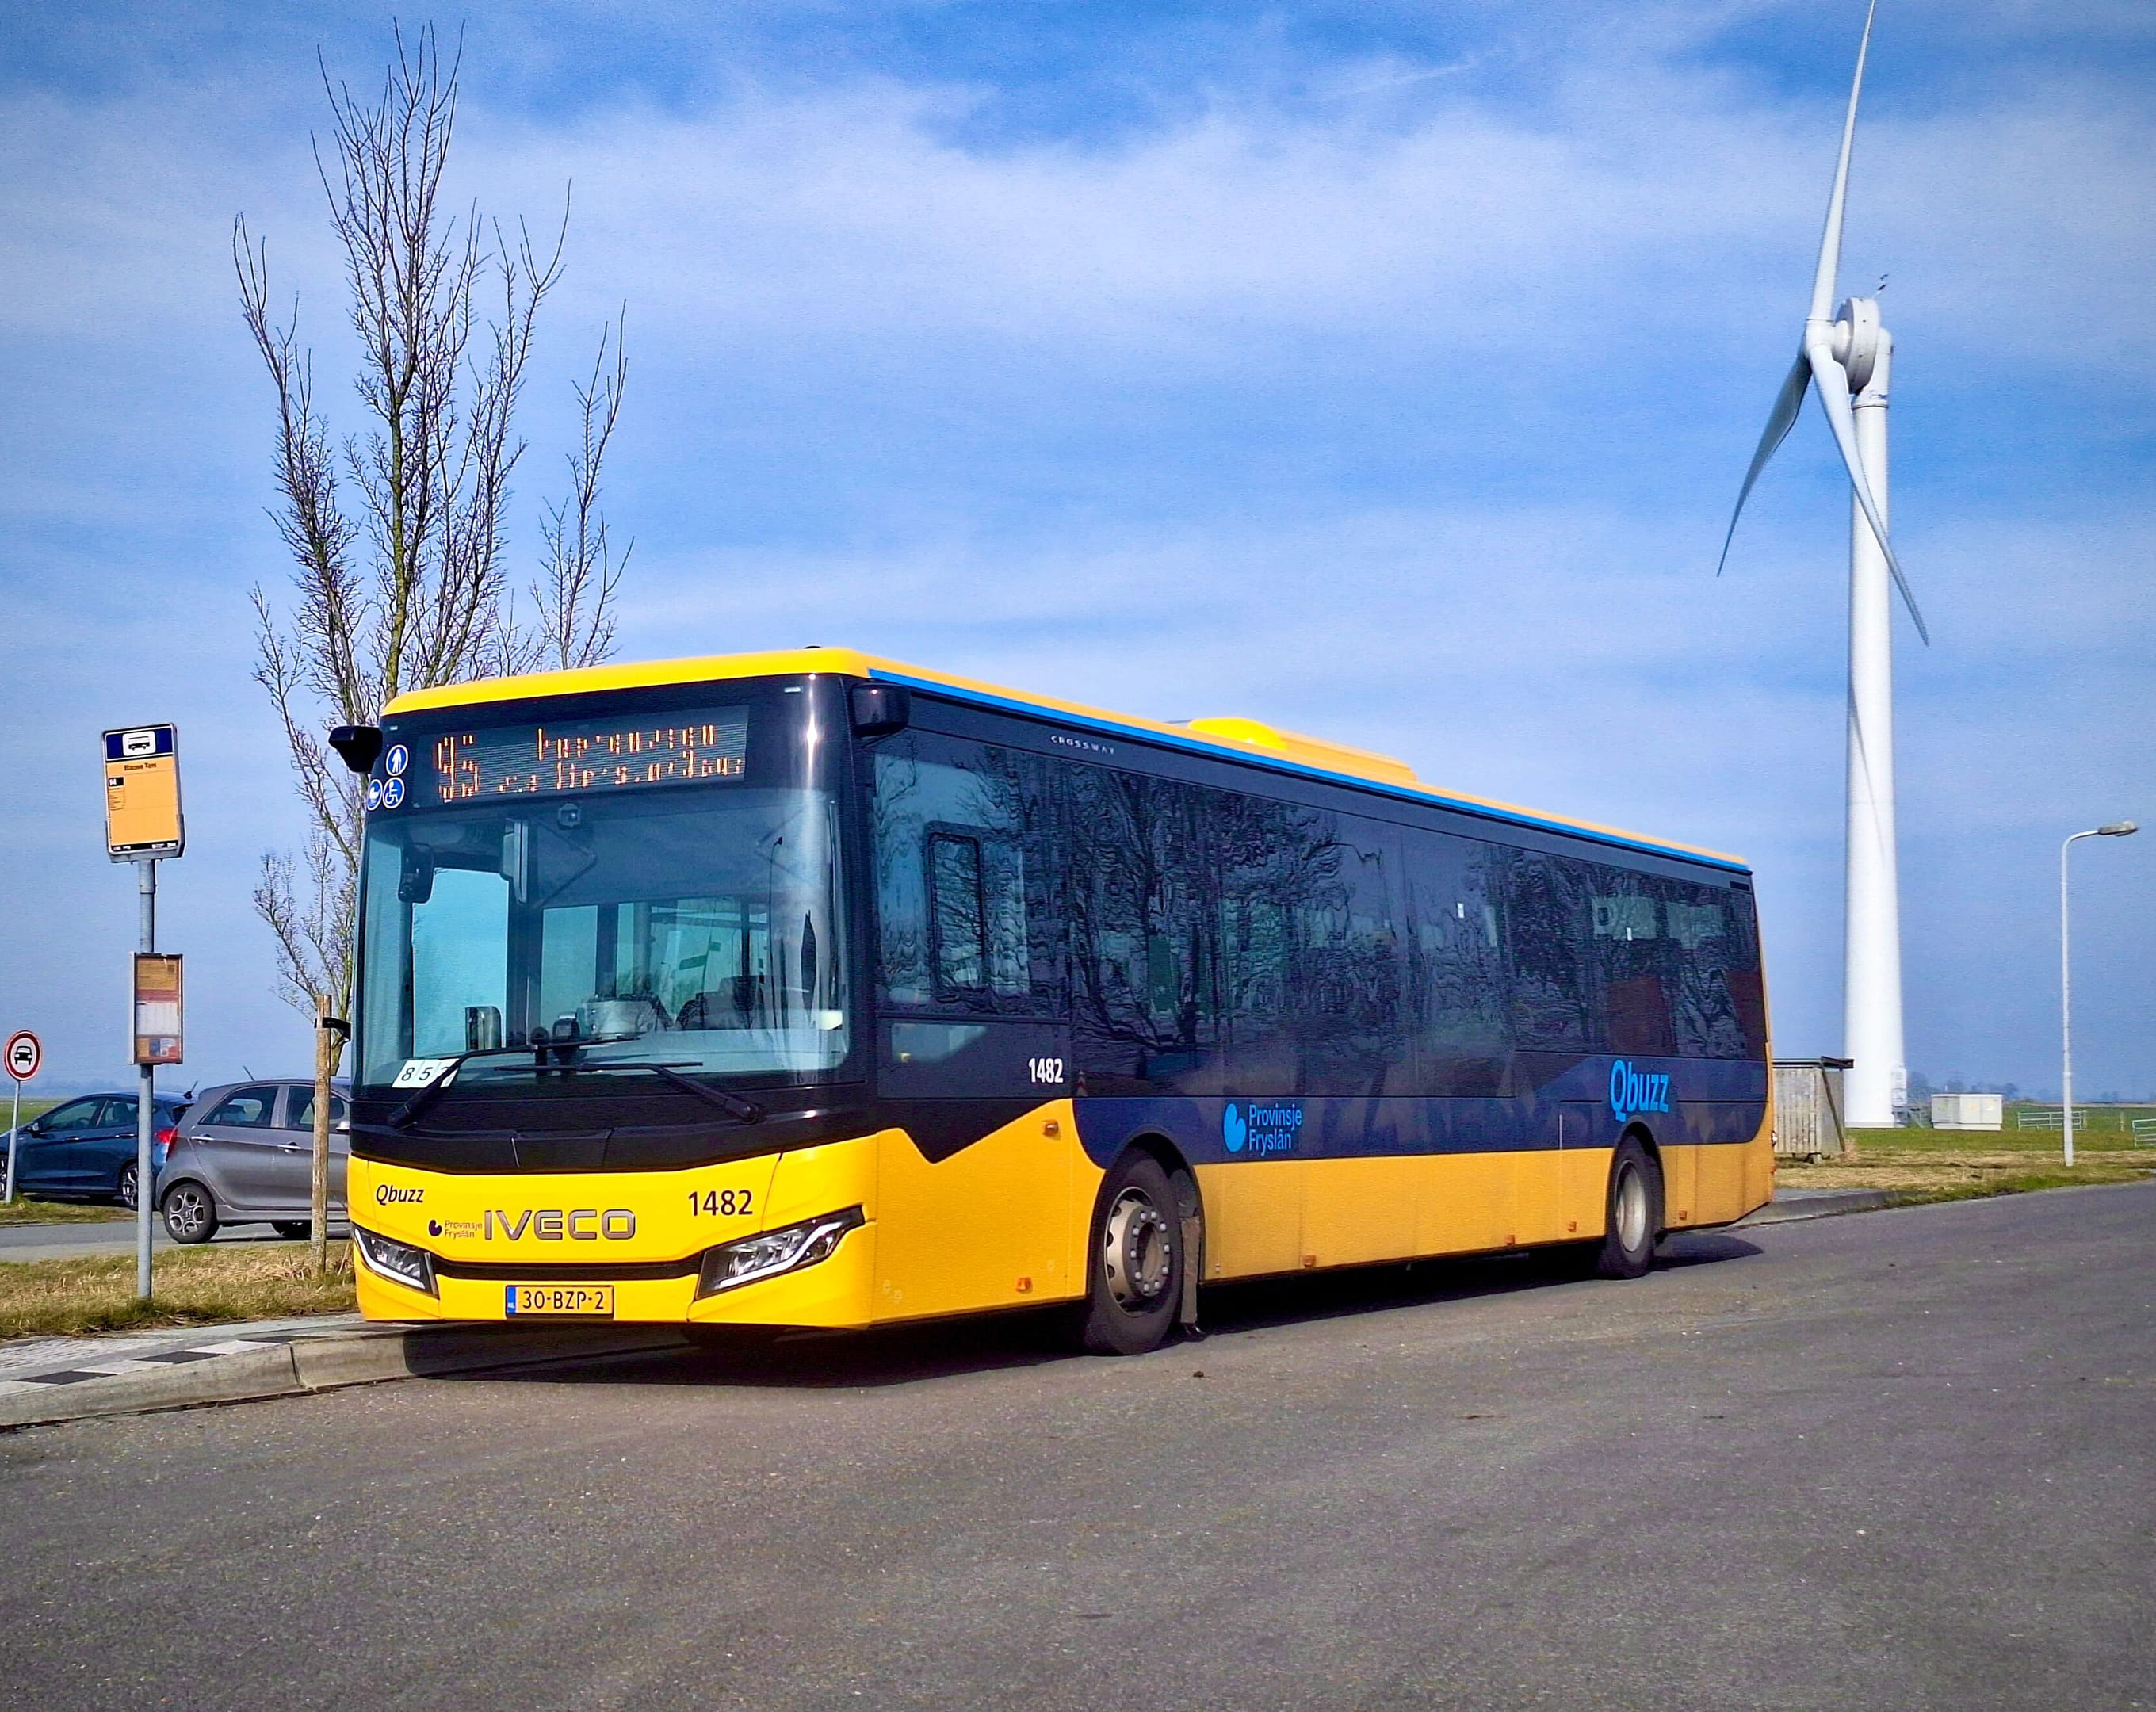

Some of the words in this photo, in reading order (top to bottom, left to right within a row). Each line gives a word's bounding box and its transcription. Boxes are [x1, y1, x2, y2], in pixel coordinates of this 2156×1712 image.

[1050, 735, 1114, 755] CROSSWAY
[1028, 1057, 1064, 1083] 1482
[1611, 1060, 1669, 1122] Qbuzz
[1249, 1103, 1302, 1131] Provinsje
[1249, 1128, 1292, 1156] Fryslân
[376, 1184, 425, 1206] Qbuzz
[688, 1189, 753, 1217] 1482
[484, 1209, 636, 1241] IVECO
[522, 1290, 605, 1310] 30-BZP-2
